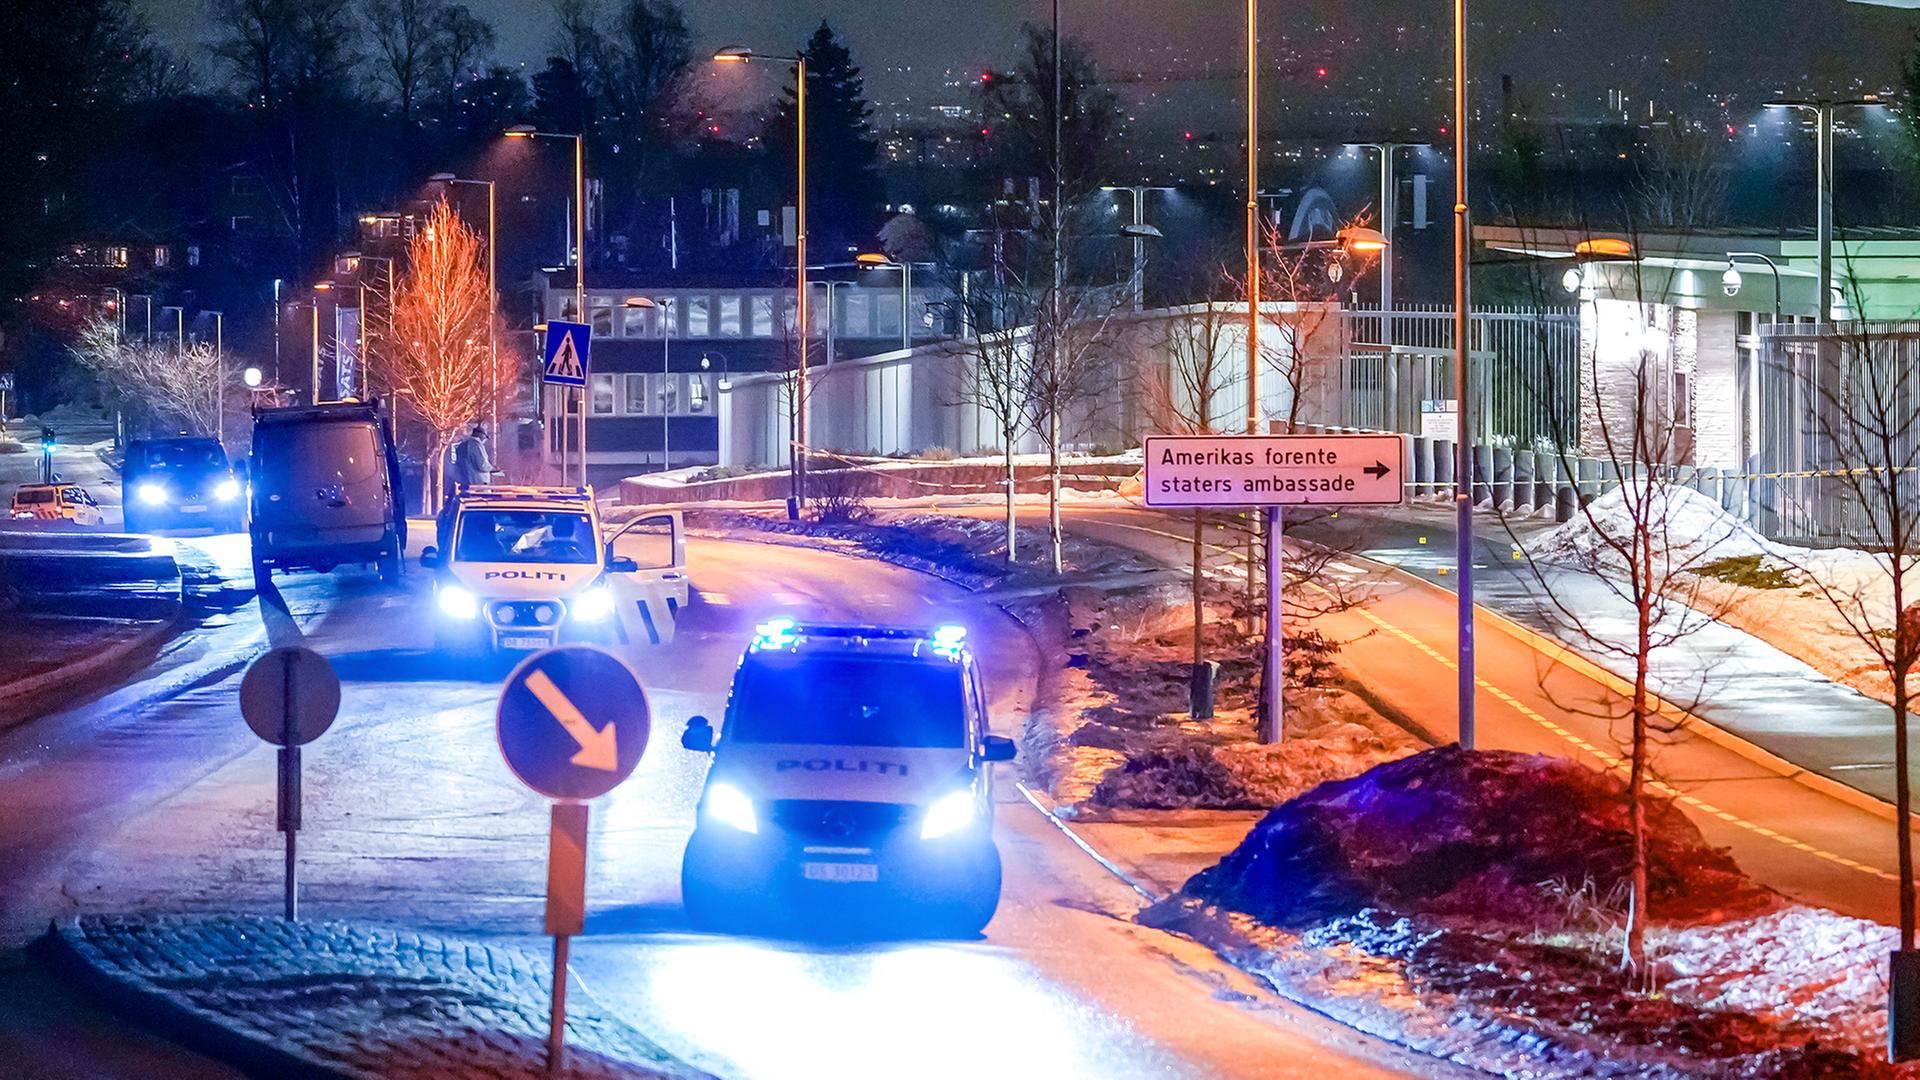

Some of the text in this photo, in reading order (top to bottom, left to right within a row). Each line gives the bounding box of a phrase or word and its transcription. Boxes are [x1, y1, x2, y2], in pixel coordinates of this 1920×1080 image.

[1161, 448, 1337, 465] Amerikas forente
[1161, 475, 1355, 492] staters ambassade
[485, 571, 565, 581] POLITI
[776, 759, 908, 776] POLITI
